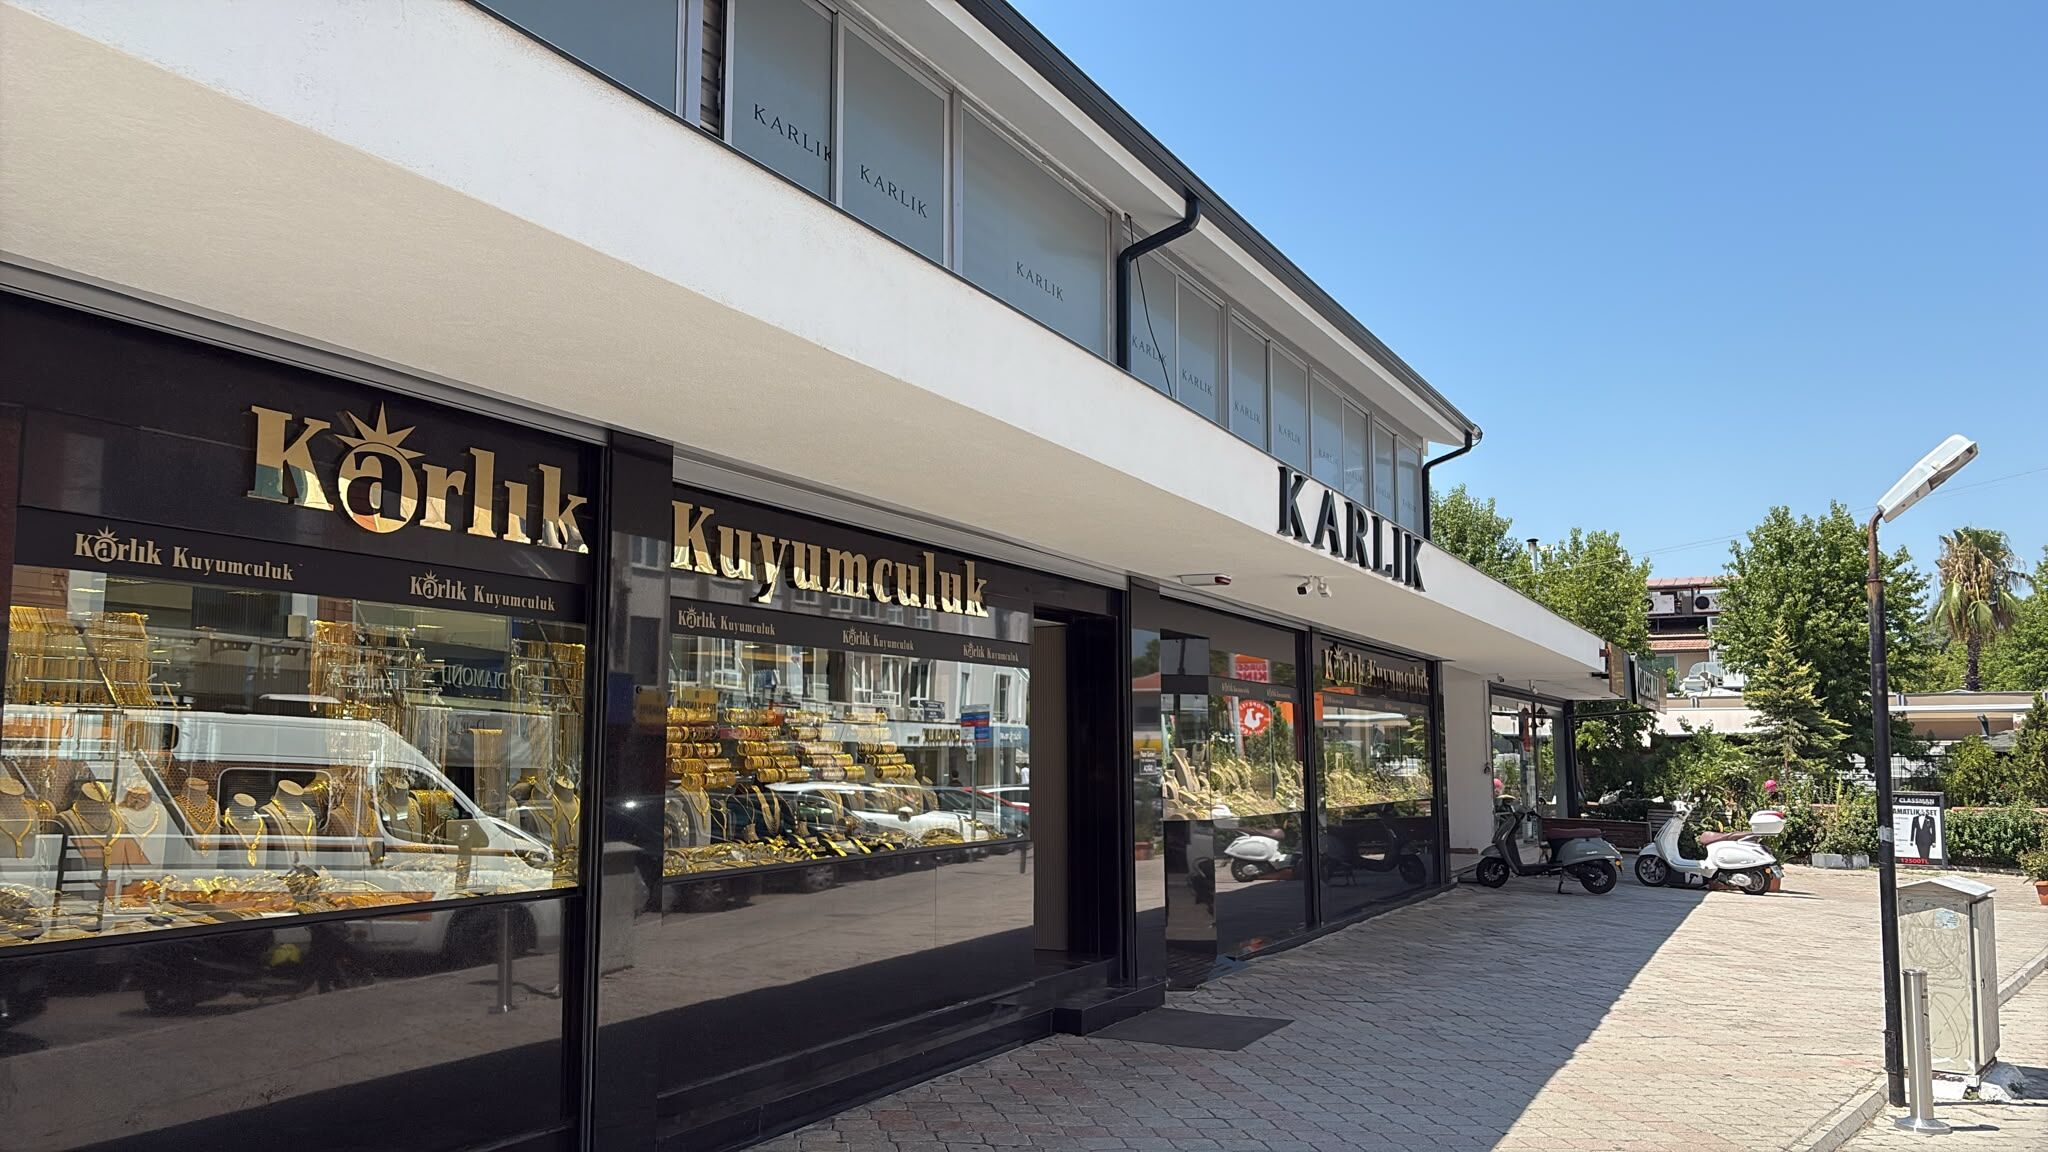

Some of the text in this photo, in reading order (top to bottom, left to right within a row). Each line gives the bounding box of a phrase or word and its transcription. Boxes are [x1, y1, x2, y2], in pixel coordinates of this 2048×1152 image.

[859, 164, 928, 218] KARLIK
[1016, 261, 1064, 301] KARLIK
[1132, 335, 1168, 366] KARLIK
[1181, 368, 1213, 396] KARLIK
[247, 401, 989, 617] Karlık Kuyumculuk
[1277, 465, 1426, 592] KARLIK
[74, 526, 294, 582] Karlık Kuyumculuk
[410, 570, 556, 612] Karlık Kuyumculuk
[720, 615, 776, 635] Kuyumculuk
[873, 634, 914, 651] Kuyumculuk
